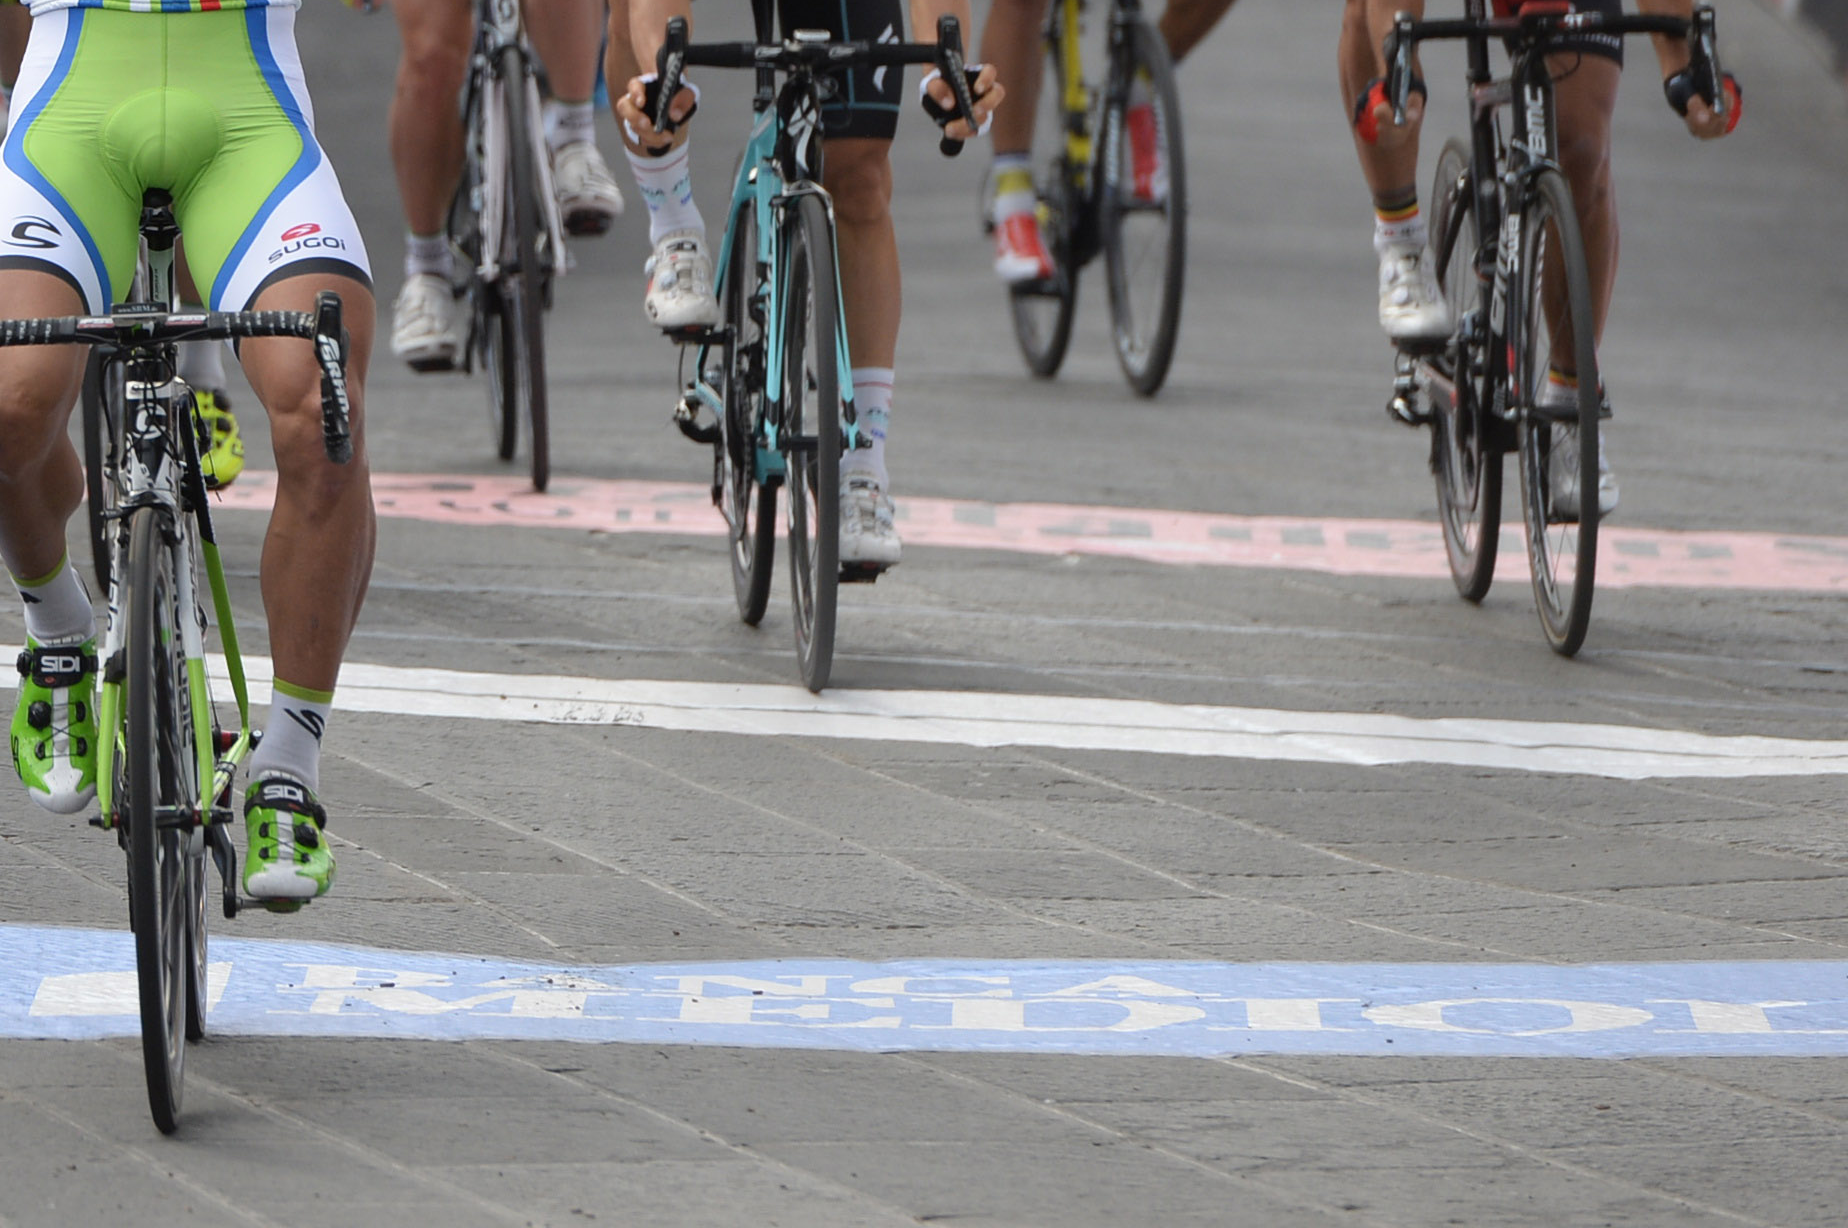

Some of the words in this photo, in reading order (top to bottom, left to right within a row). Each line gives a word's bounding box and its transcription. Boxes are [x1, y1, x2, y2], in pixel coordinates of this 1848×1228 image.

[1524, 83, 1548, 159] BMC
[40, 655, 81, 674] SIDI
[262, 784, 304, 804] SIDI
